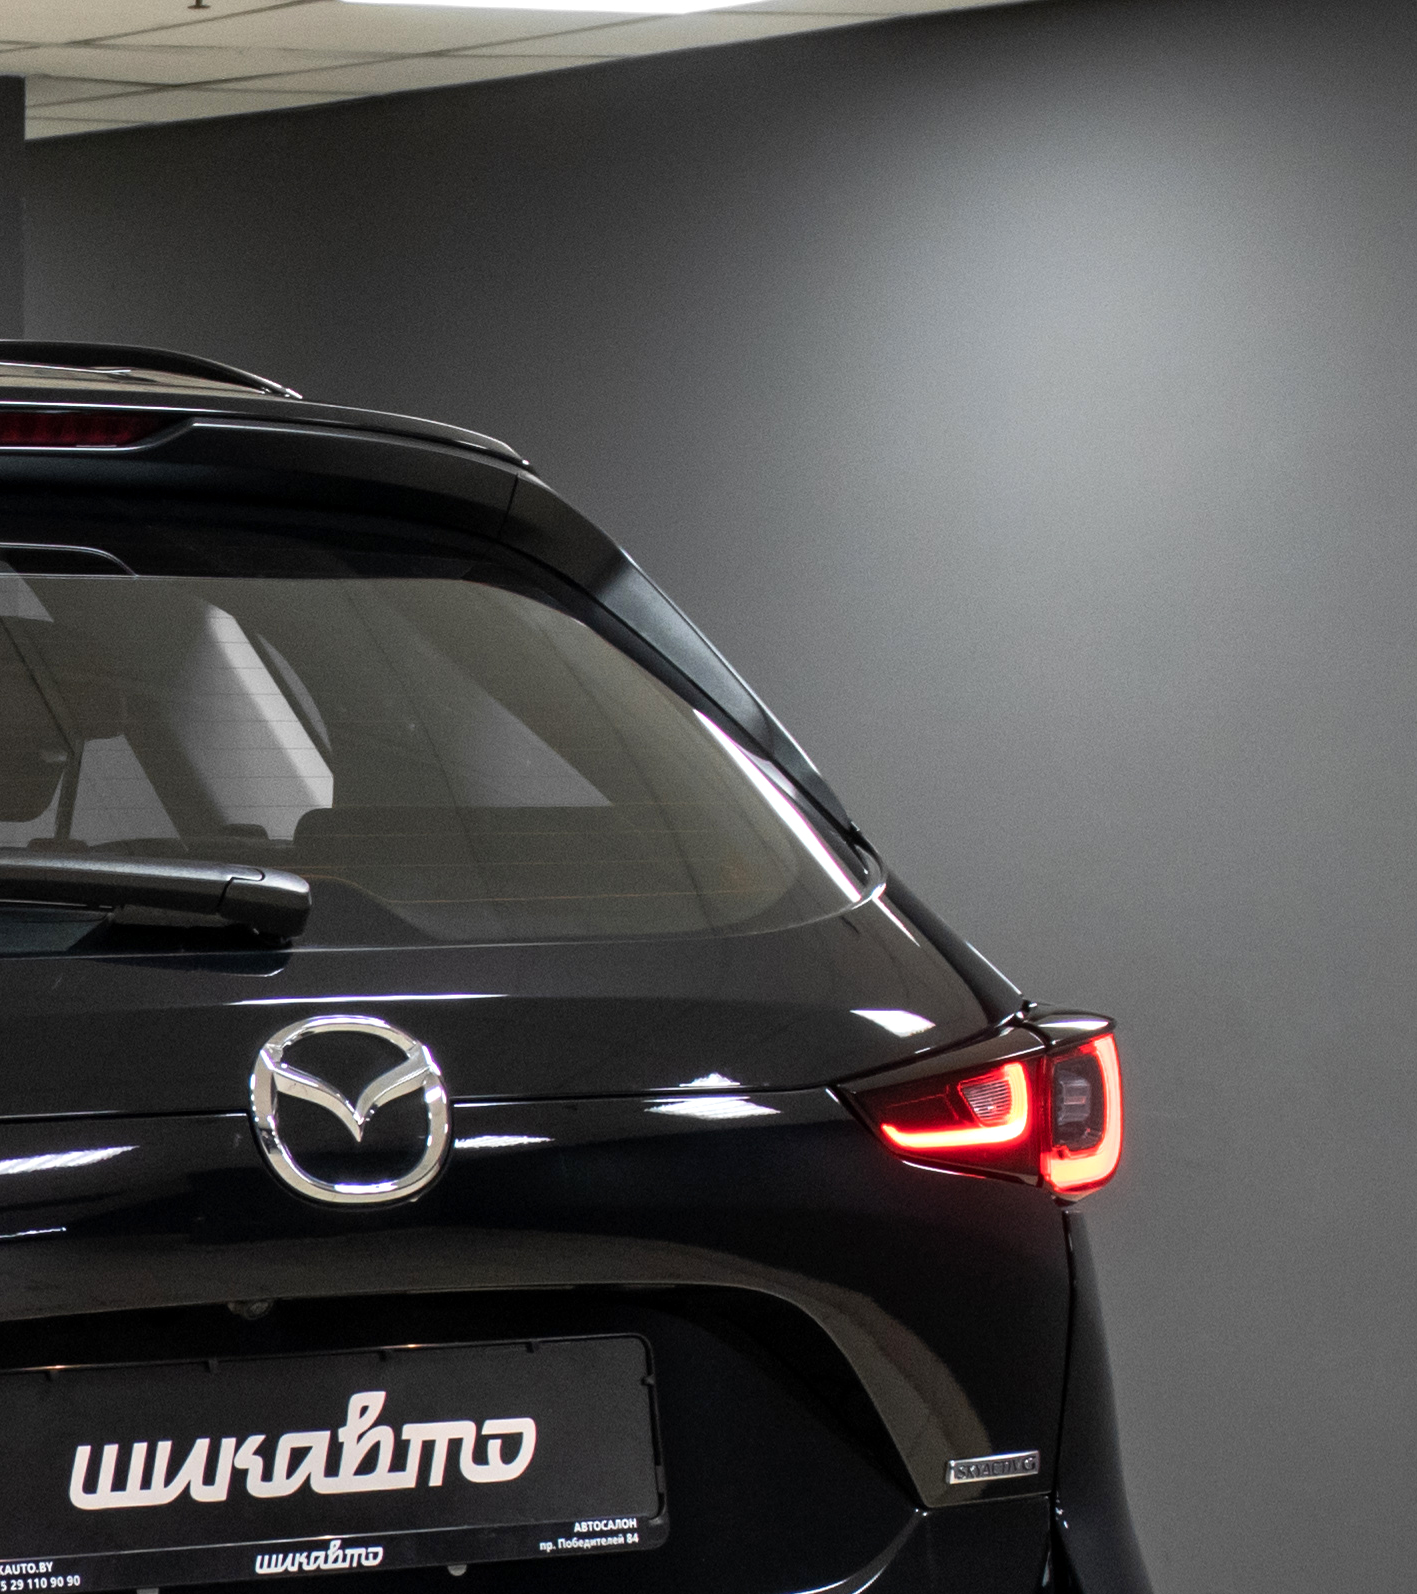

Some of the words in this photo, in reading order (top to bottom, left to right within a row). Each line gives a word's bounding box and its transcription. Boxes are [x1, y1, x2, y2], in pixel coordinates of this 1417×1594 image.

[69, 1391, 537, 1510] шикавто
[573, 1518, 638, 1533] АВТОСАЛОН
[539, 1541, 556, 1553] пр.
[557, 1533, 625, 1549] Победителей
[626, 1532, 639, 1544] 84
[255, 1539, 384, 1575] шикавто
[10, 1579, 25, 1591] 29
[27, 1577, 48, 1590] 110
[50, 1576, 65, 1588] 90
[66, 1575, 82, 1587] 90
